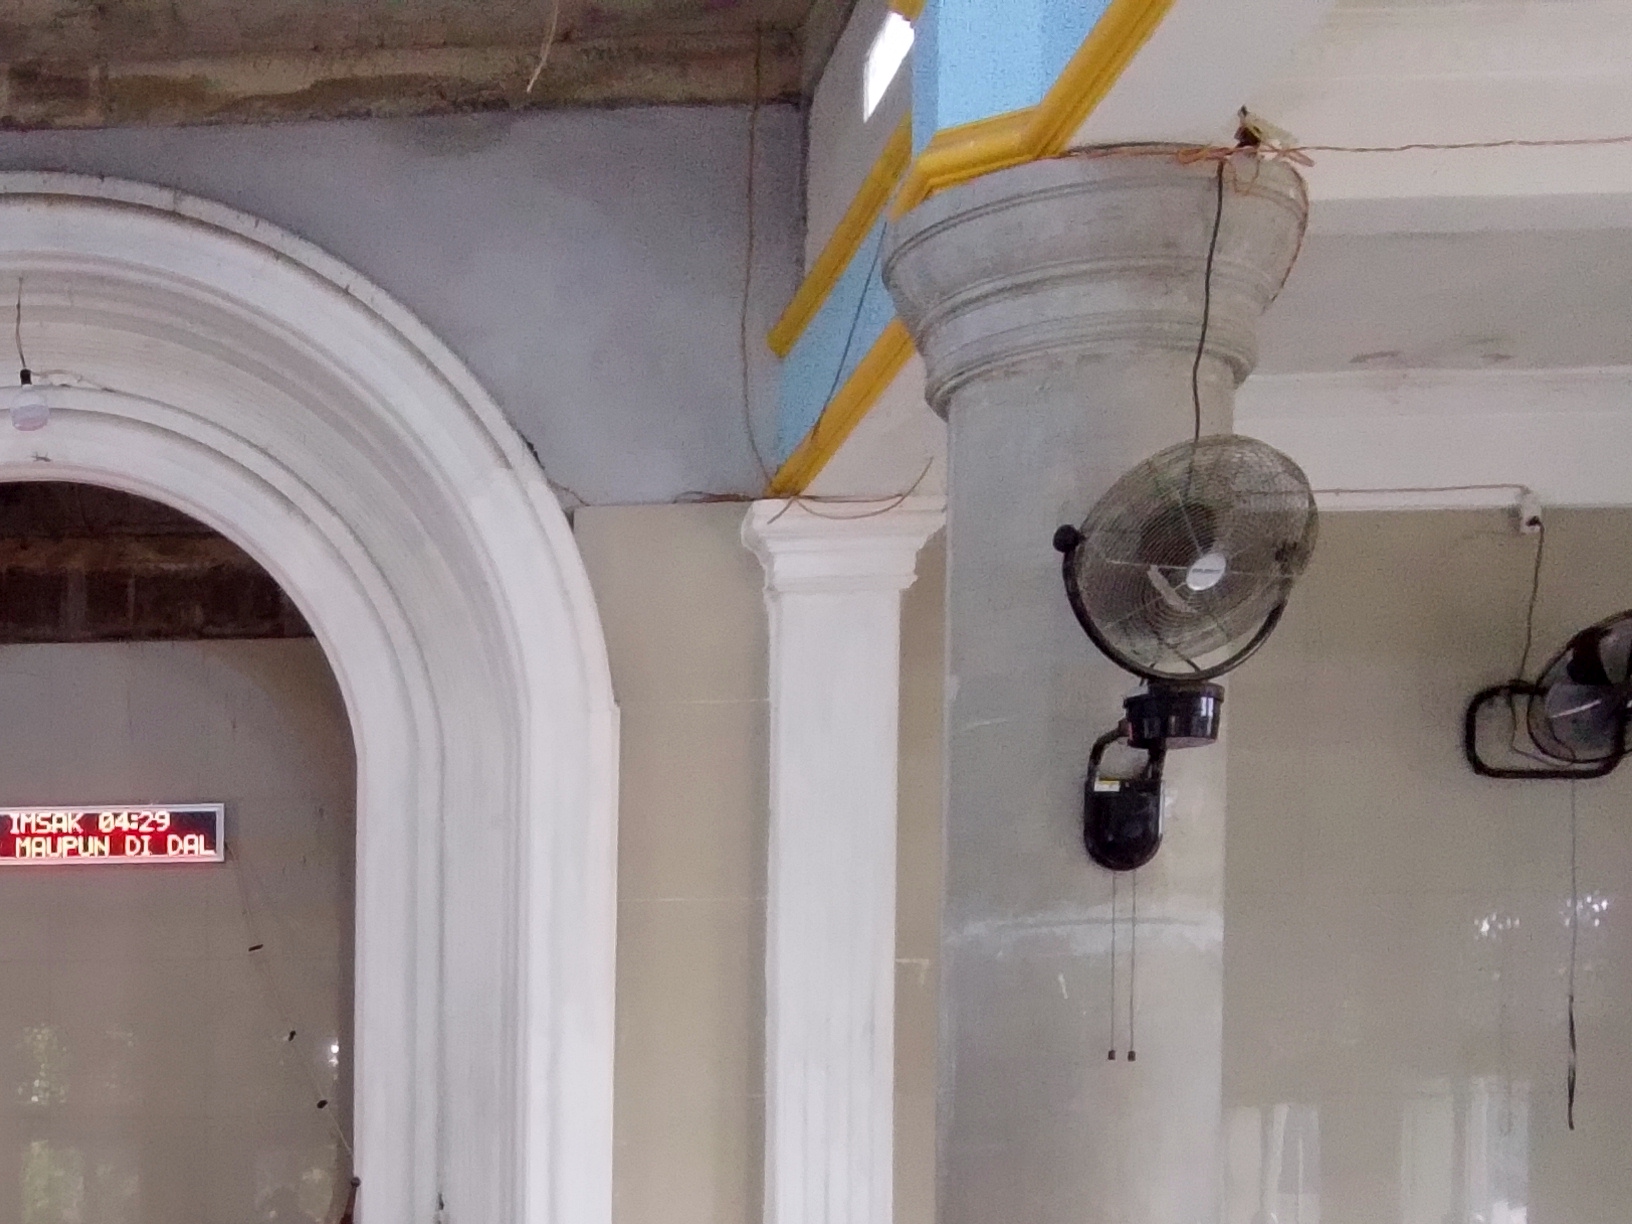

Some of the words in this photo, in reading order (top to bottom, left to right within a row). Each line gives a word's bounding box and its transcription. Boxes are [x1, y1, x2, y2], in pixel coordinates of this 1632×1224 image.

[9, 812, 84, 834] IMSAK
[97, 810, 170, 832] 04:29
[15, 834, 111, 858] MAUPUN
[125, 834, 151, 856] DI
[167, 833, 216, 855] DAL
